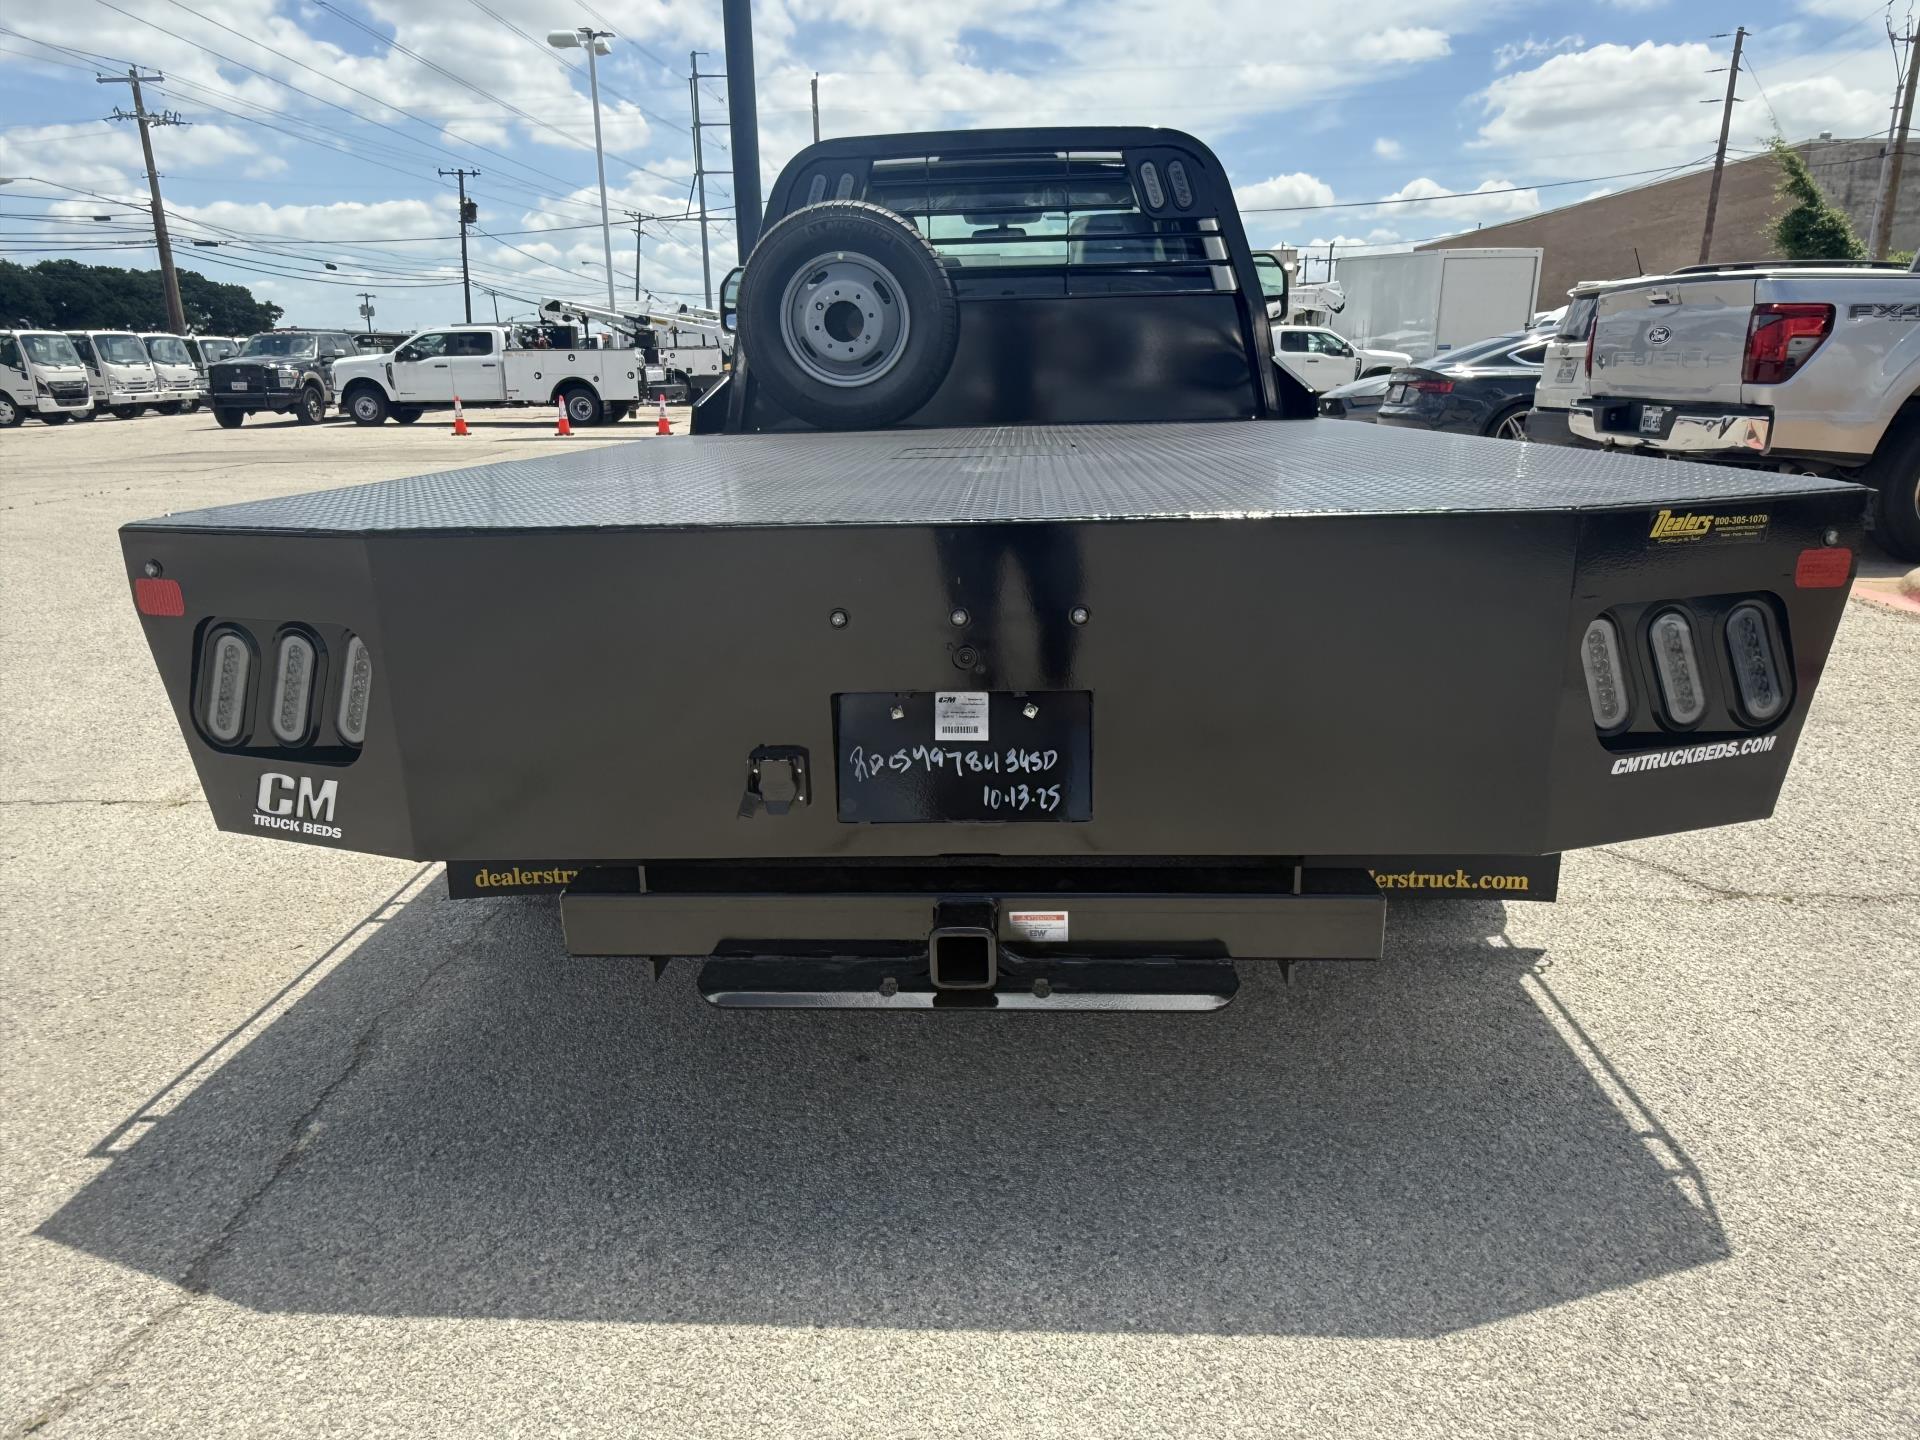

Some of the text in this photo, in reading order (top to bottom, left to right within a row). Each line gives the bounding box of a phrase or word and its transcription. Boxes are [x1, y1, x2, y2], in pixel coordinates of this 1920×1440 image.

[1649, 509, 1768, 538] Dealers 800-305-1070
[1611, 736, 1776, 775] CMTRUCKBEDS.COM
[257, 772, 338, 822] CM
[252, 813, 342, 839] TRUCK BEDS
[475, 867, 578, 888] dealerstr
